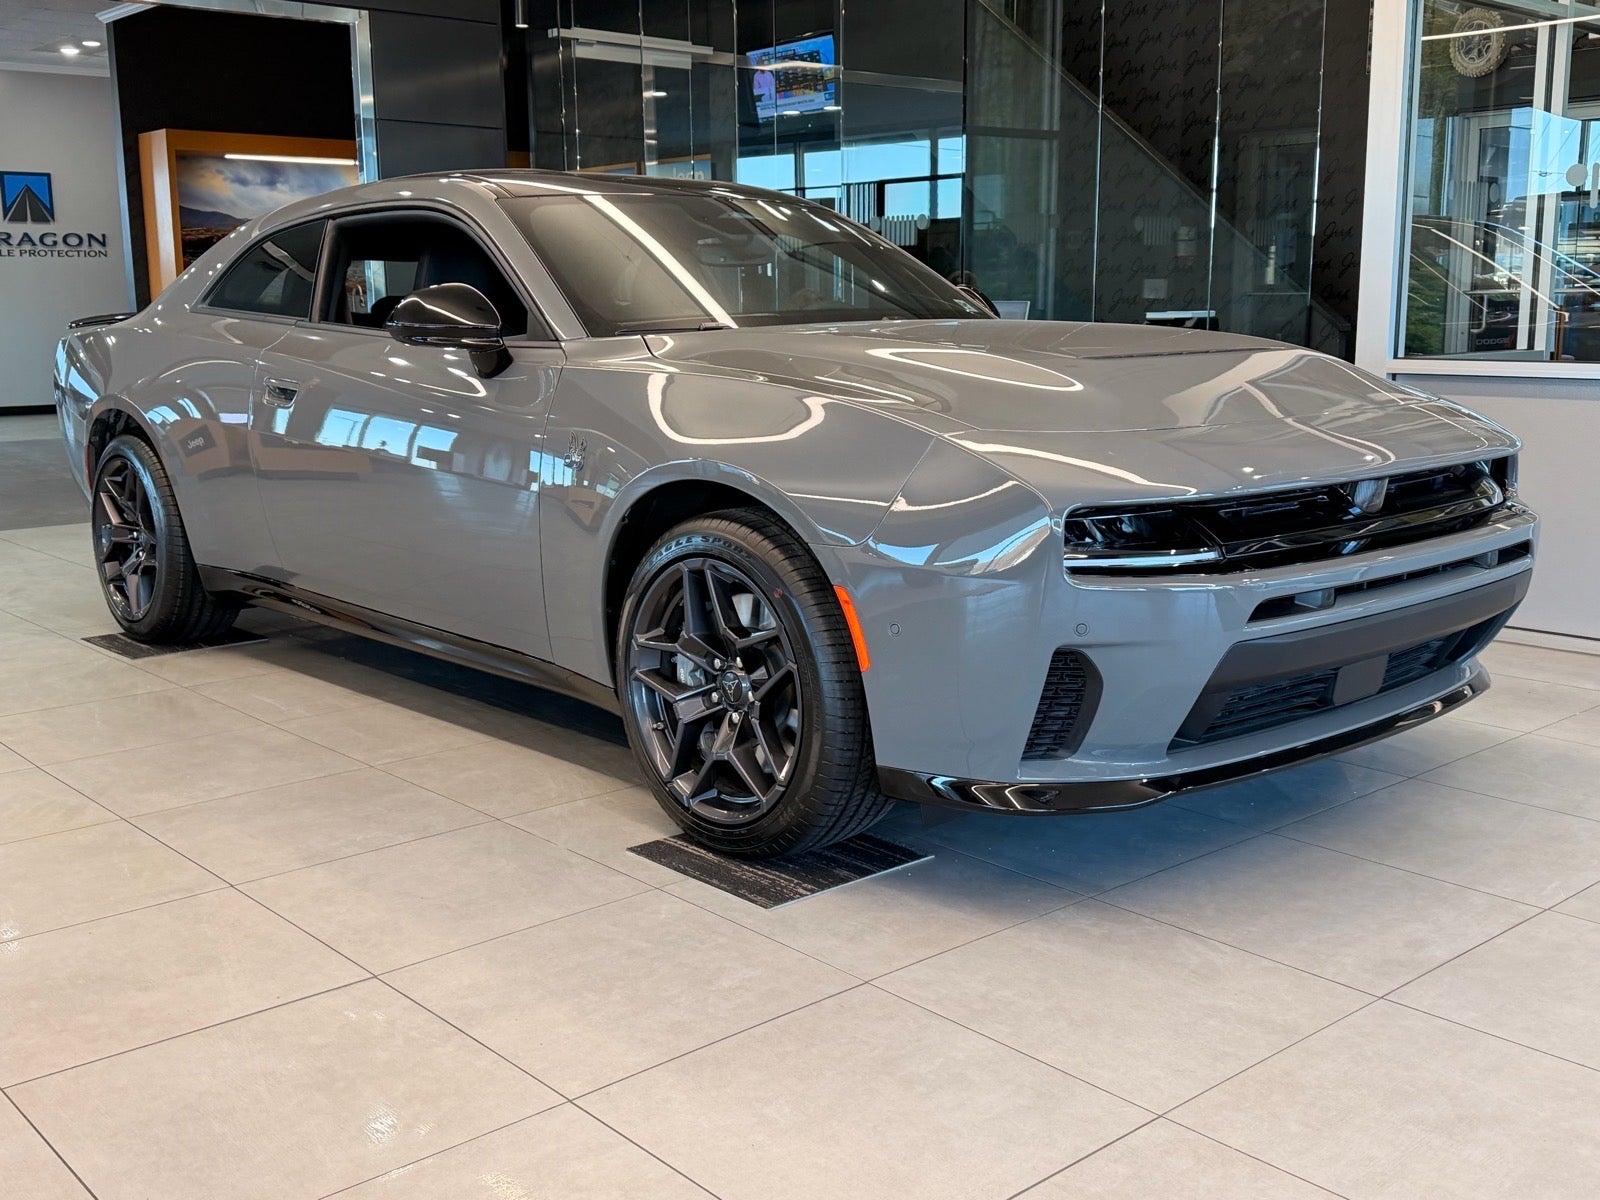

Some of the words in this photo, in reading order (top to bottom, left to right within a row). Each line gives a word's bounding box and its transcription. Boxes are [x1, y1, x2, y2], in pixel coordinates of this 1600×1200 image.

[19, 249, 108, 258] PROTECTION
[1475, 337, 1509, 345] DODGE
[186, 436, 205, 449] Jeep
